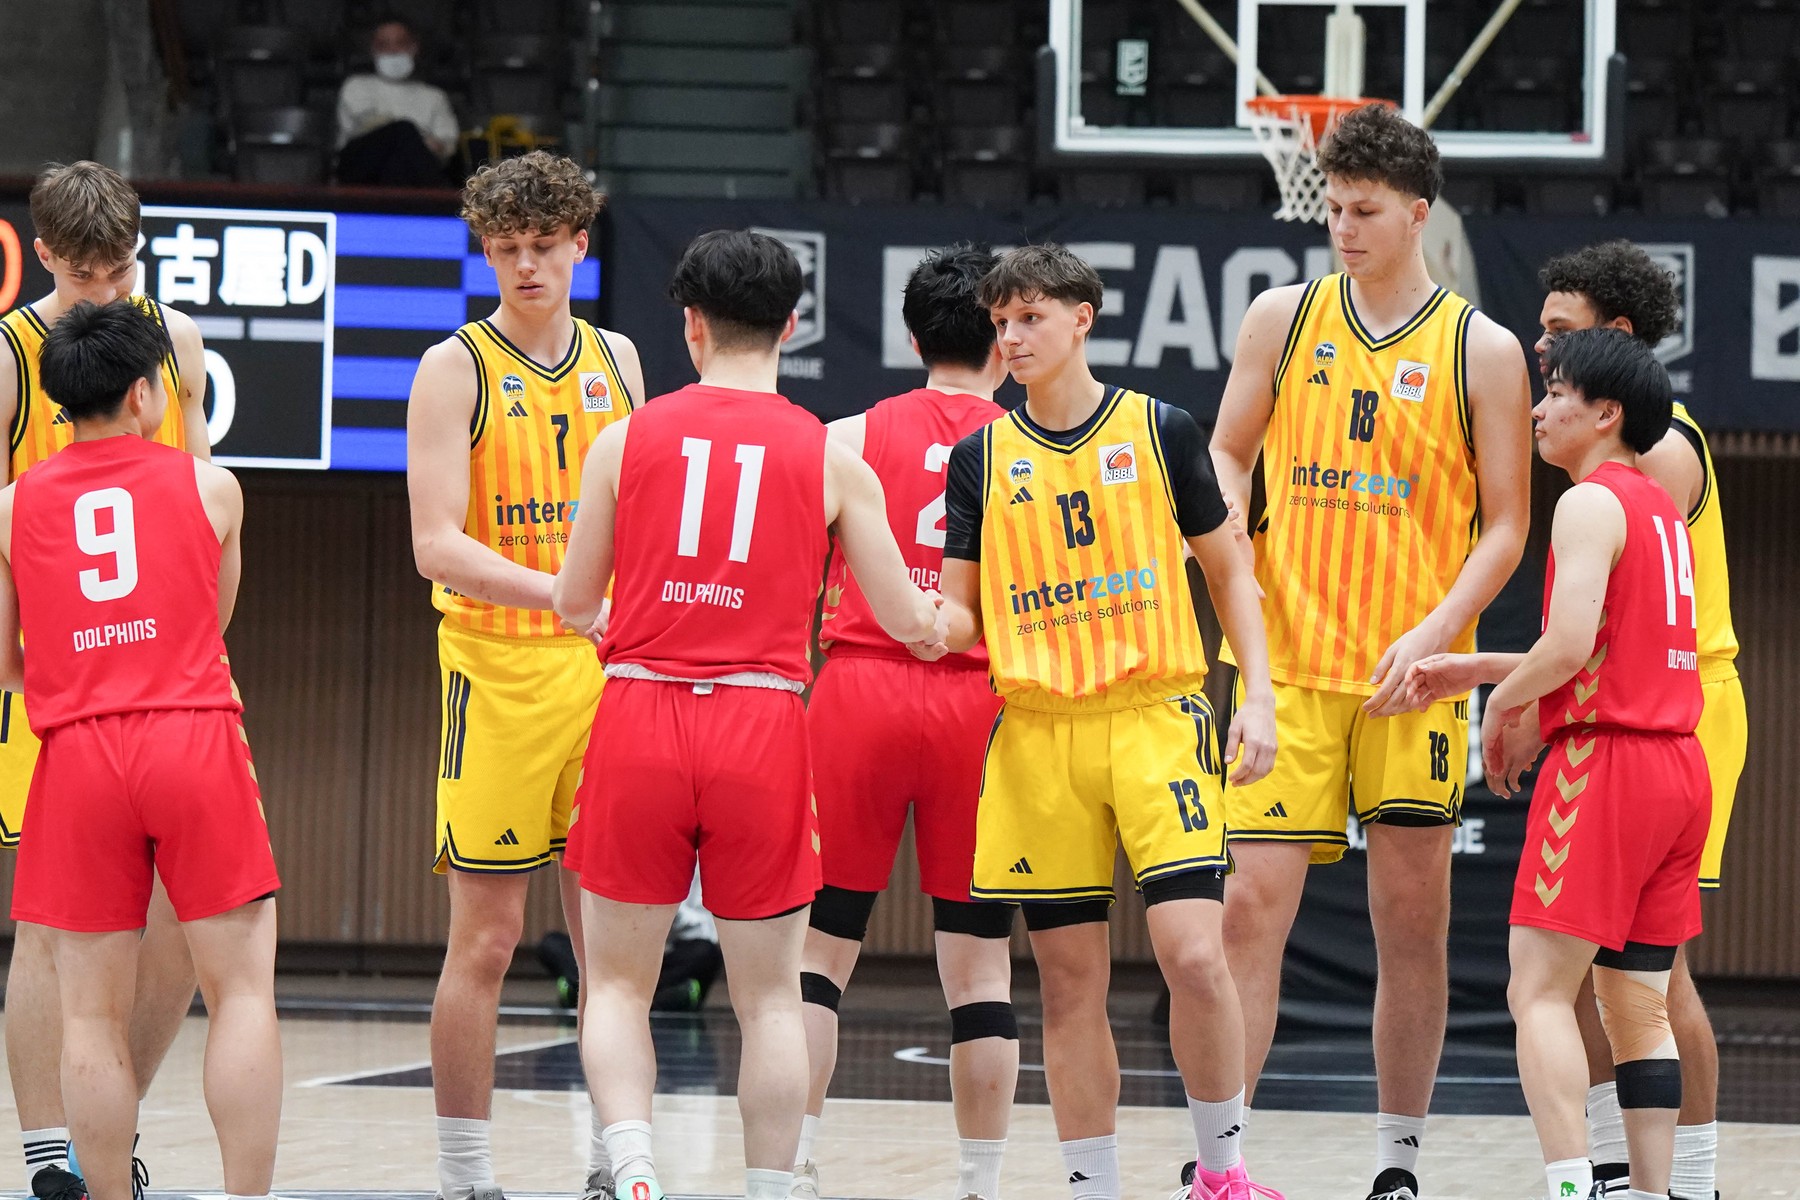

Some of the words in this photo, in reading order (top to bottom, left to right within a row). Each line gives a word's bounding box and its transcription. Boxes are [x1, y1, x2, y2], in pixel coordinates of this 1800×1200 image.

[137, 223, 328, 307] 古屋D
[586, 397, 610, 409] NBBL
[1394, 383, 1421, 398] NBBL
[1349, 389, 1379, 442] 18
[551, 414, 569, 469] 7
[1105, 467, 1134, 481] NBBL
[495, 494, 579, 526] interz
[677, 436, 766, 563] 11
[1056, 490, 1095, 549] 13
[1289, 495, 1308, 506] zero
[1310, 497, 1350, 510] waste
[1353, 501, 1411, 518] solutions
[73, 486, 139, 603] 9
[498, 534, 530, 546] zero
[534, 531, 568, 545] waste
[1652, 515, 1697, 629] 14
[661, 580, 745, 610] DOLPHINS
[1016, 619, 1047, 636] zero
[1050, 609, 1093, 628] waste
[1097, 598, 1160, 619] solutions
[73, 618, 157, 653] DOLPHINS
[1428, 730, 1449, 782] 18
[1168, 778, 1209, 833] 13
